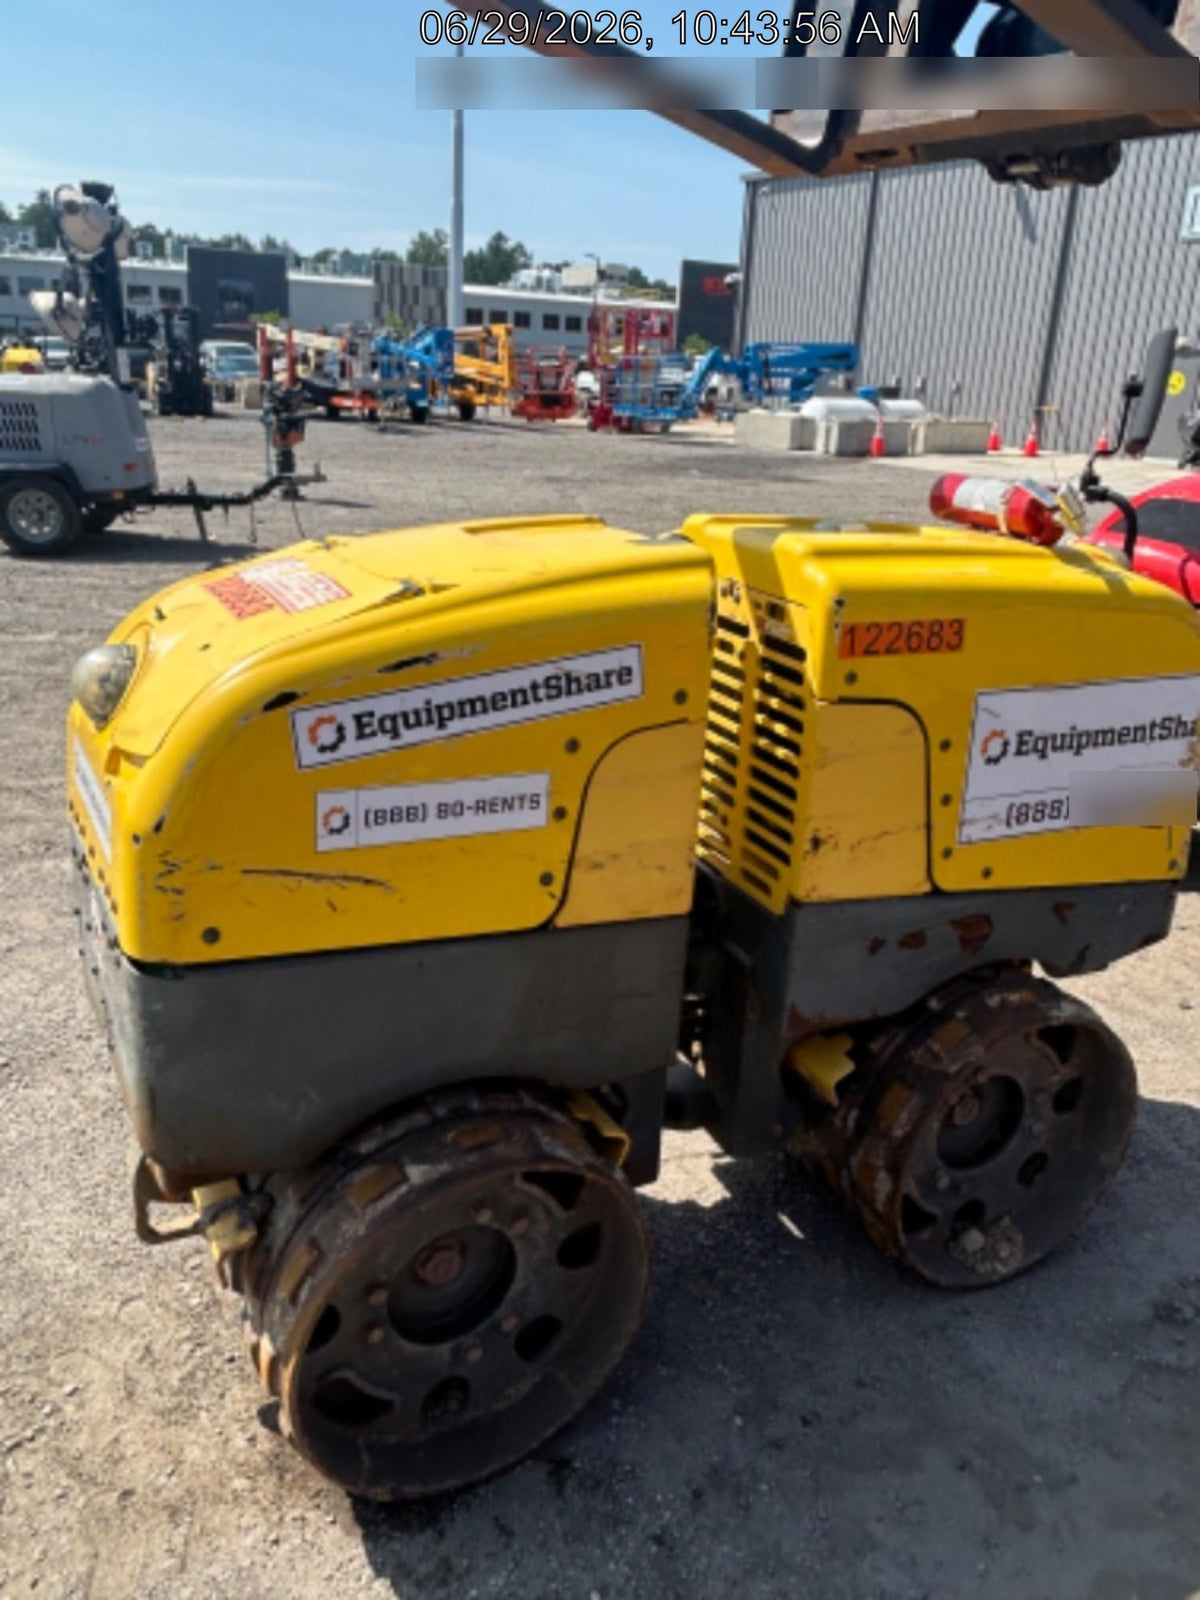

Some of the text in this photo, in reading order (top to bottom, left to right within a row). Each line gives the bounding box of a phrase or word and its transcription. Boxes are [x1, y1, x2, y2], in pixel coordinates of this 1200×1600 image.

[844, 618, 964, 656] 122683
[352, 665, 633, 741] EquipmentShare
[364, 793, 541, 829] (888) 80-RENTS
